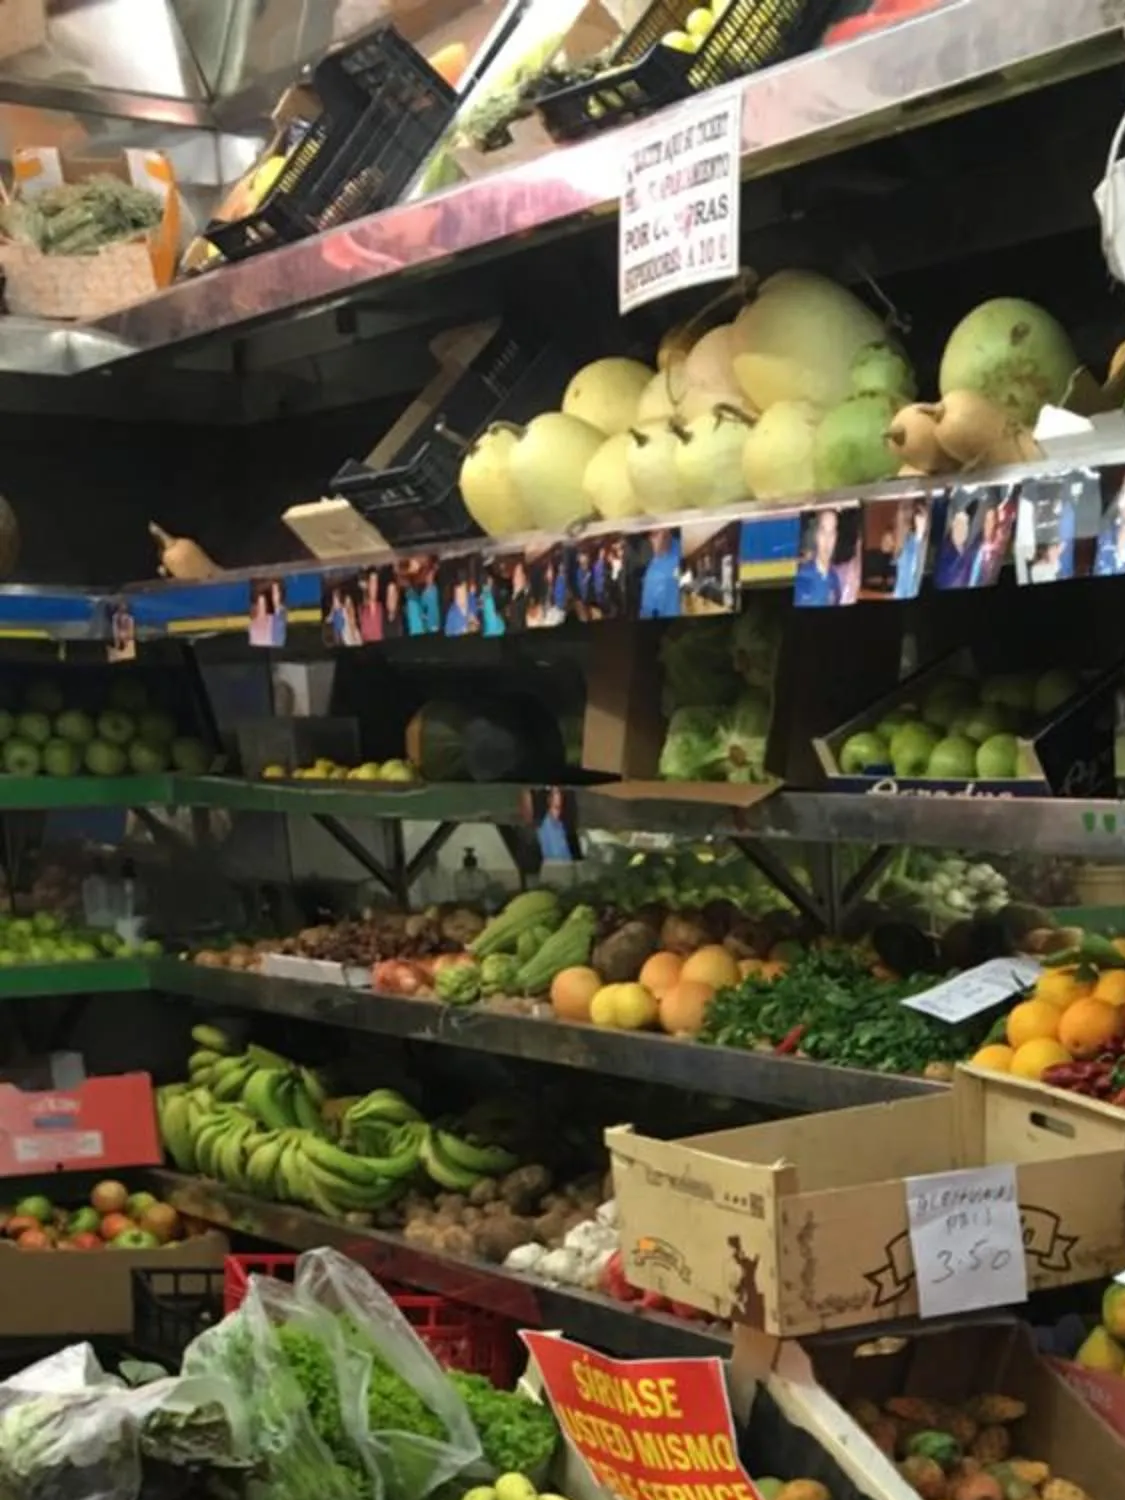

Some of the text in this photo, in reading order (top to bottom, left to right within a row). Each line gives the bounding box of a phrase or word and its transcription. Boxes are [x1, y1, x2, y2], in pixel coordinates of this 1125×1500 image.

[931, 1237, 1012, 1285] 3.50
[556, 1402, 738, 1474] USTED MISMO
